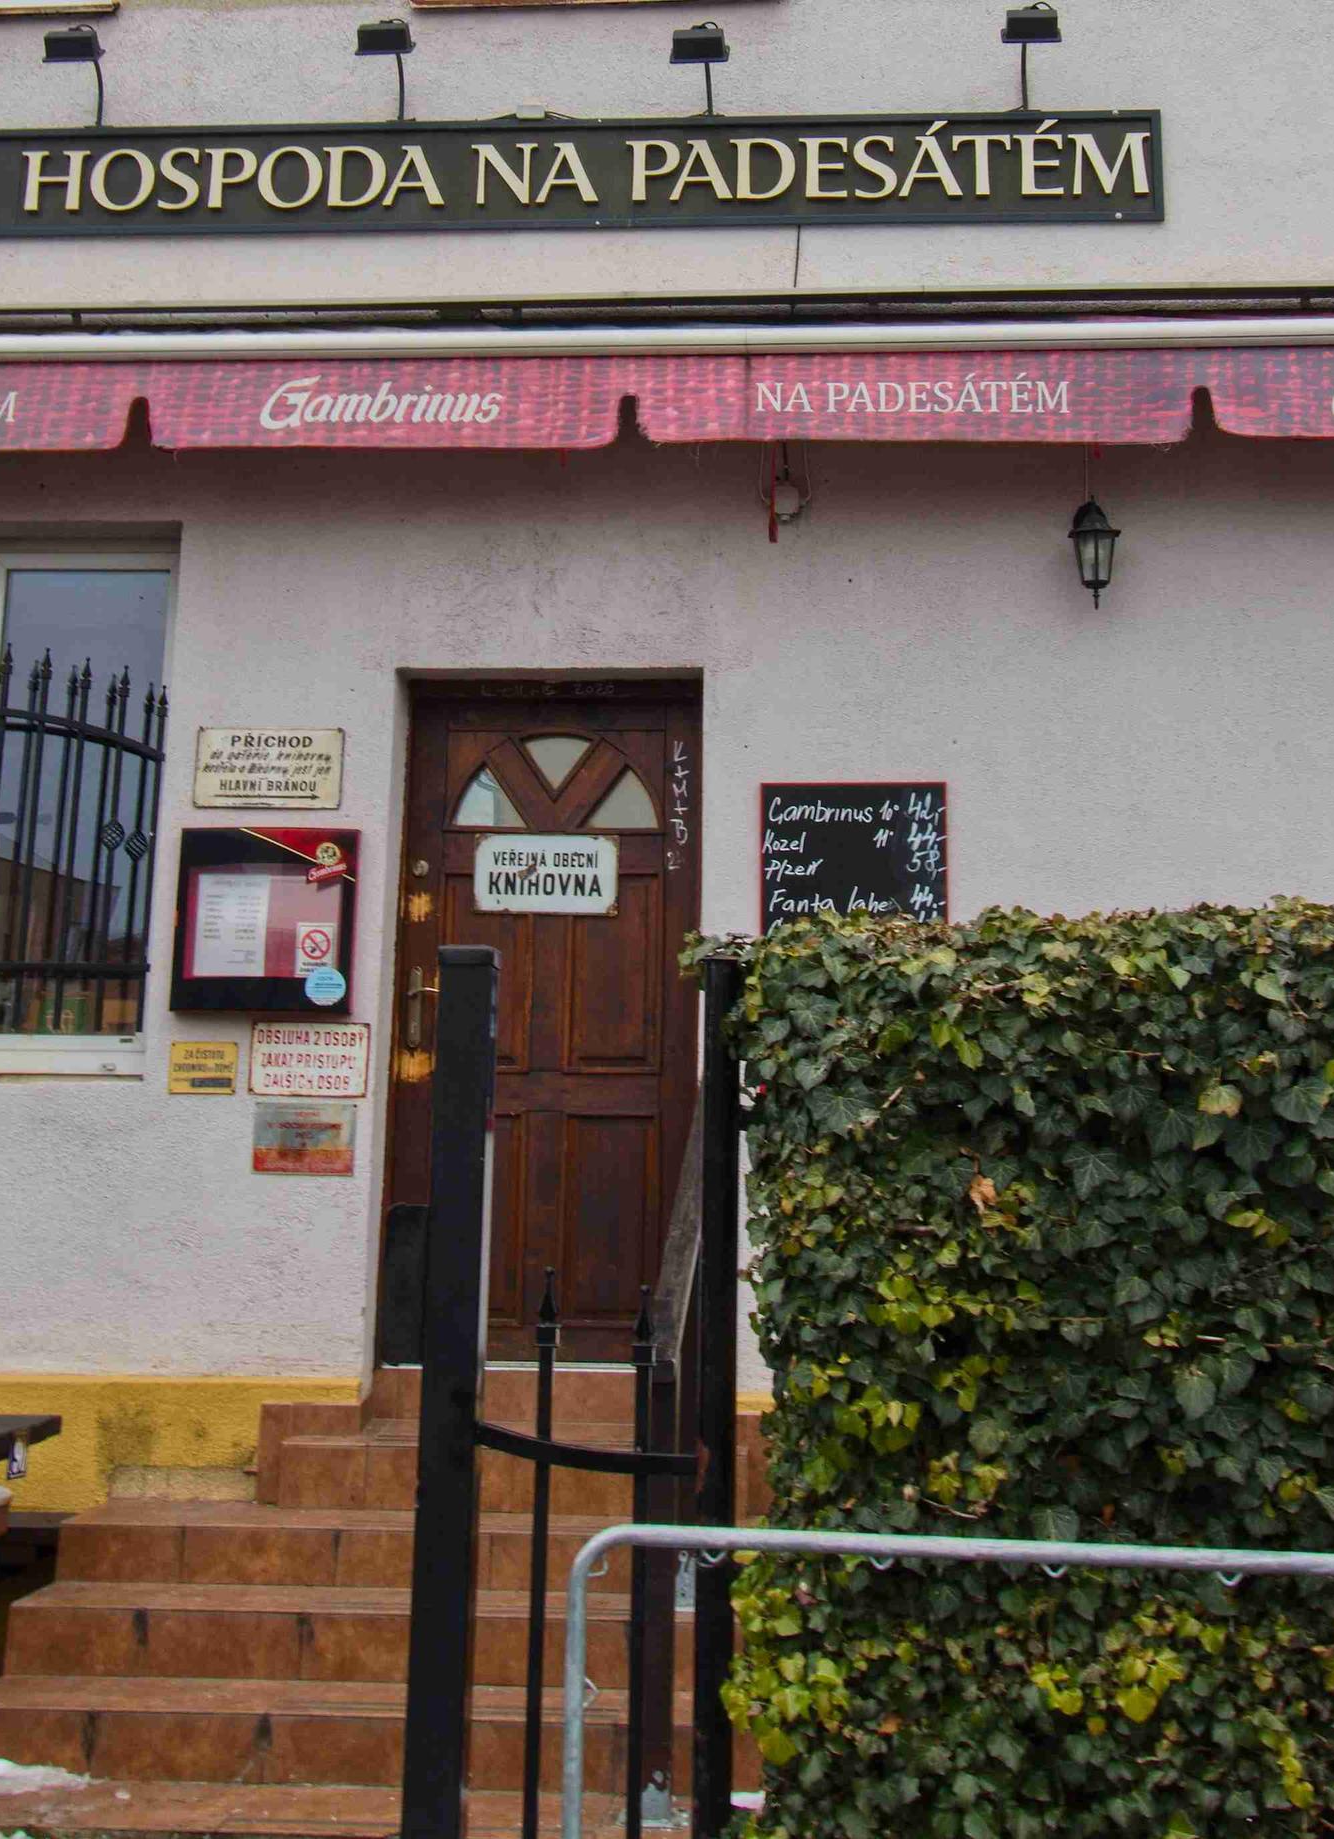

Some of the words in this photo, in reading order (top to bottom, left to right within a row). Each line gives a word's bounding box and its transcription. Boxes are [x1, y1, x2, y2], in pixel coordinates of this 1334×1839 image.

[22, 145, 445, 211] HOSPODA
[471, 142, 598, 206] NA
[625, 119, 1151, 202] PADESÁTÉM
[259, 375, 507, 429] Gambrinus
[755, 381, 815, 413] NA
[825, 373, 1071, 413] PADESÁTÉM
[231, 733, 314, 748] PŘÍCHOD
[219, 778, 263, 792] HLAVNÍ
[769, 797, 874, 824] Gambrinus
[762, 829, 806, 854] Kozel
[493, 848, 547, 867] VEŘEJNÁ
[489, 871, 603, 897] KNIHOVNA
[769, 888, 836, 913] Fanta
[846, 886, 895, 914] lahe
[257, 1028, 310, 1045] OBSLUHA
[313, 1030, 322, 1046] 2
[324, 1029, 364, 1047] OSOBY
